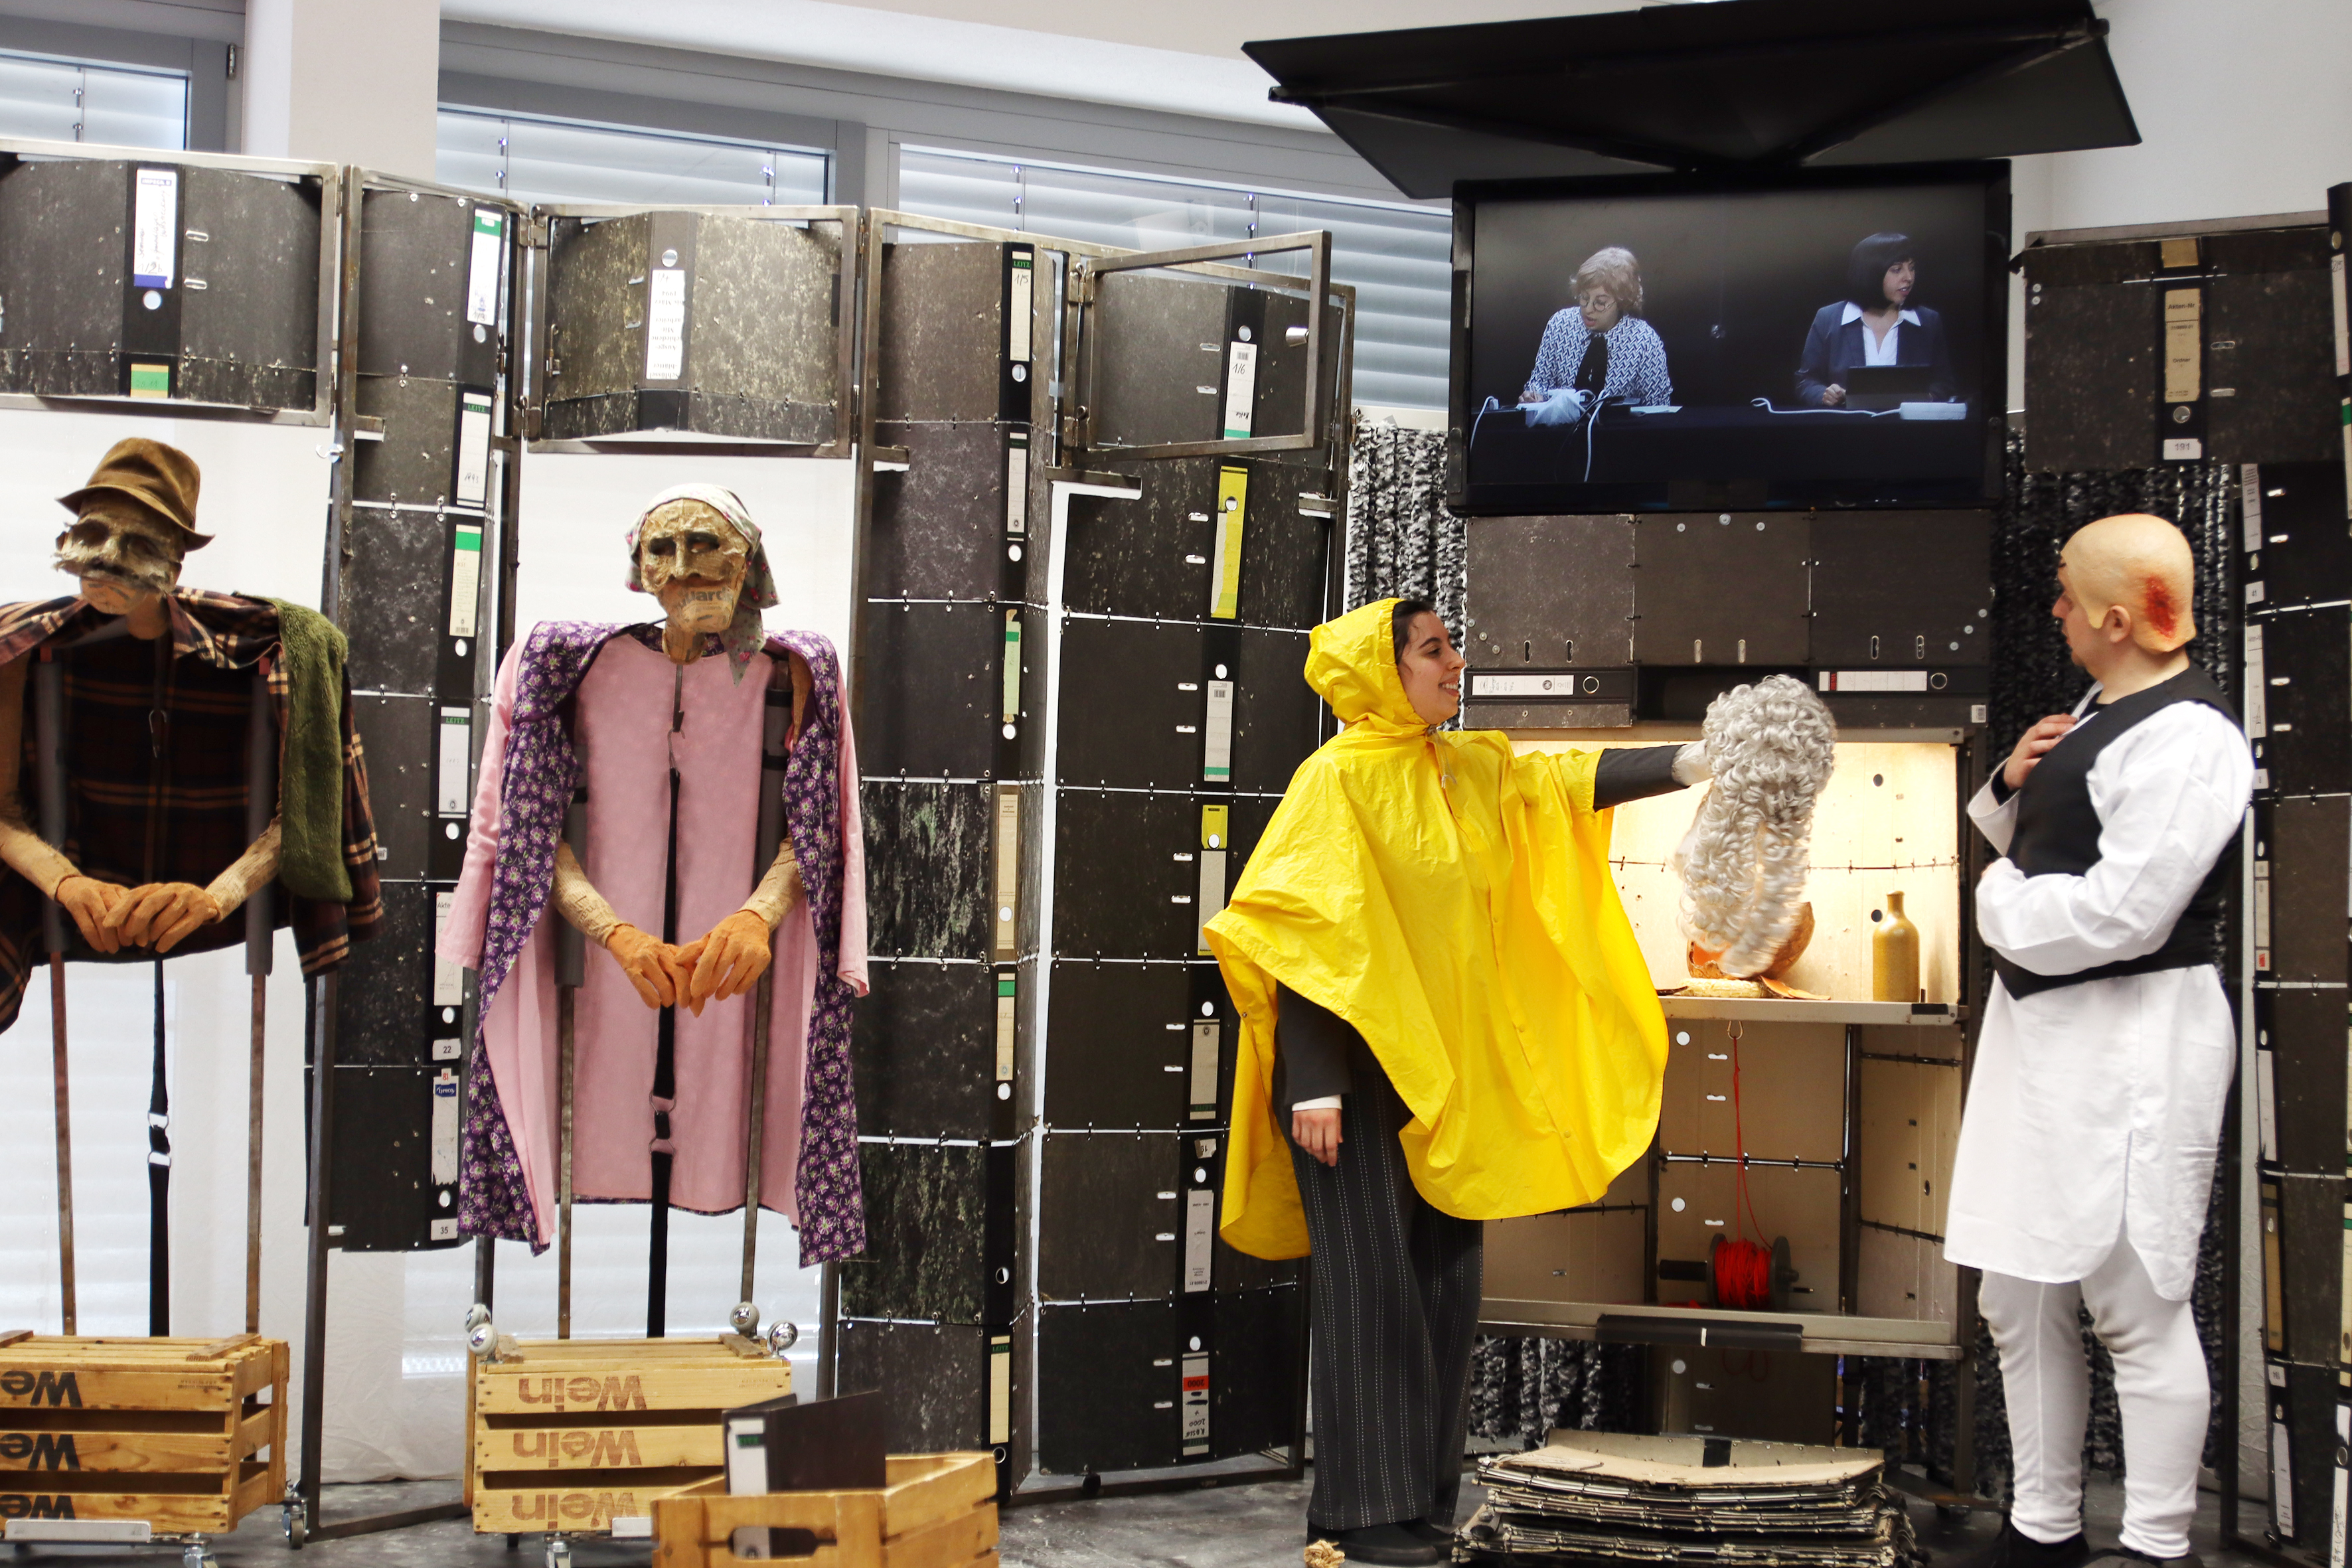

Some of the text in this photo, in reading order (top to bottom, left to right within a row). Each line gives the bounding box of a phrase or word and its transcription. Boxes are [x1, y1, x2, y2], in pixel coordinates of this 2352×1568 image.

[1014, 274, 1029, 286] 1/5
[1232, 363, 1245, 374] 1/6
[467, 404, 486, 413] LEITZ
[1188, 1379, 1204, 1387] 2000
[518, 1375, 647, 1412] Wein
[1189, 1418, 1206, 1427] 2000
[512, 1430, 642, 1468] Wein
[512, 1492, 639, 1529] Wein
